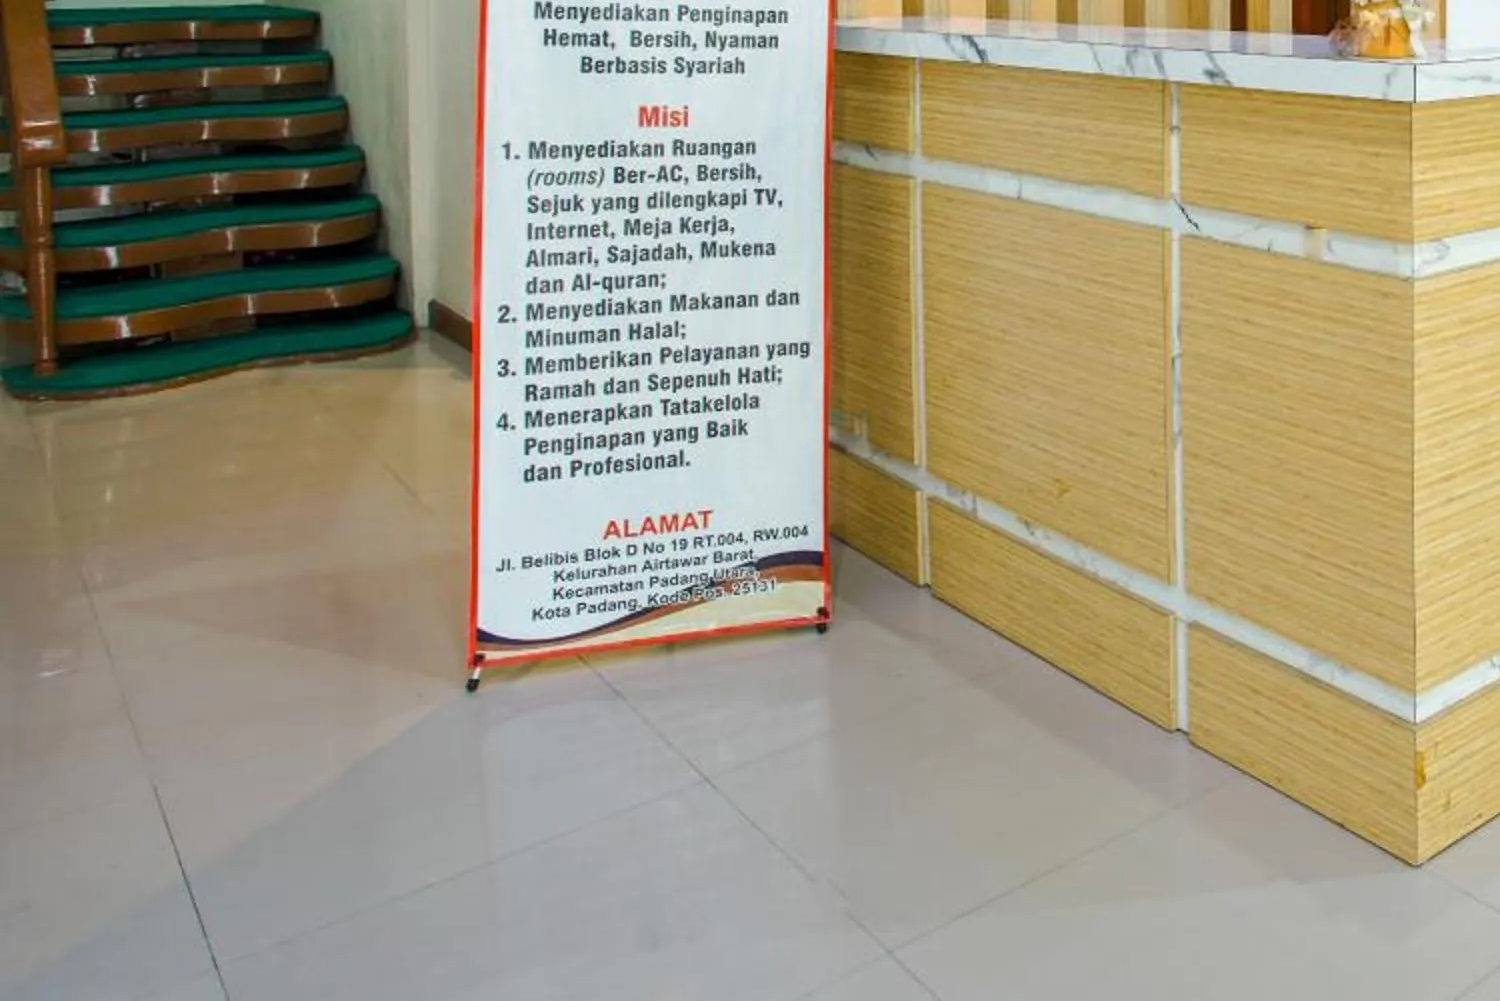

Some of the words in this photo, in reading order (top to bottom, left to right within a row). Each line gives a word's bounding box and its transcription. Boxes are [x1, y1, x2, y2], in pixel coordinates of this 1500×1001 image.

[534, 1, 669, 25] Menyediakan
[678, 4, 788, 27] Penginapan
[543, 29, 615, 50] Hemat,
[630, 29, 697, 50] Bersih,
[705, 31, 779, 52] Nyaman
[580, 57, 667, 74] Berbasis
[674, 56, 745, 77] Syariah
[638, 106, 689, 128] Misi
[501, 144, 520, 160] 1.
[528, 141, 665, 162] Menyediakan
[672, 139, 756, 159] Ruangan
[527, 167, 605, 190] (rooms)
[614, 168, 689, 185] Ber-AC,
[697, 165, 762, 183] Bersih,
[527, 195, 584, 216] Sejuk
[592, 197, 639, 215] yang
[647, 189, 747, 211] dilengkapi
[754, 189, 783, 207] TV,
[527, 222, 615, 240] Internet,
[623, 219, 672, 238] Meja
[680, 216, 735, 235] Kerja,
[526, 248, 599, 267] Almari,
[607, 244, 693, 264] Sajadah,
[701, 241, 776, 259] Mukena
[526, 277, 564, 295] dan
[572, 273, 667, 294] Al-quran;
[497, 305, 517, 324] 2.
[526, 298, 662, 322] Menyediakan
[670, 293, 759, 312] Makanan
[766, 289, 800, 306] dan
[526, 326, 621, 348] Minuman
[629, 321, 686, 341] Halal;
[497, 360, 516, 377] 3.
[525, 351, 651, 375] Memberikan
[659, 343, 759, 364] Pelayanan
[766, 341, 810, 359] yang
[525, 380, 596, 402] Ramah
[603, 377, 640, 396] dan
[648, 368, 730, 393] Sepenuh
[738, 365, 783, 385] Hati;
[496, 413, 516, 431] 4.
[525, 403, 652, 429] Menerapkan
[660, 393, 759, 416] Tatakelola
[524, 428, 645, 455] Penginapan
[652, 427, 699, 446] yang
[707, 419, 748, 438] Baik
[523, 464, 561, 483] dan
[570, 451, 691, 478] Profesional.
[603, 510, 713, 539] ALAMAT
[496, 557, 516, 573] Jl.
[522, 552, 579, 569] Belibis
[585, 545, 621, 562] Blok
[627, 544, 637, 557] D
[643, 540, 665, 555] No
[671, 537, 689, 551] 19
[754, 525, 809, 542] RW.004
[554, 561, 637, 583] Kelurahan
[642, 553, 708, 572] Airtawar
[553, 577, 643, 601] Kecamatan
[531, 603, 571, 621] Kota
